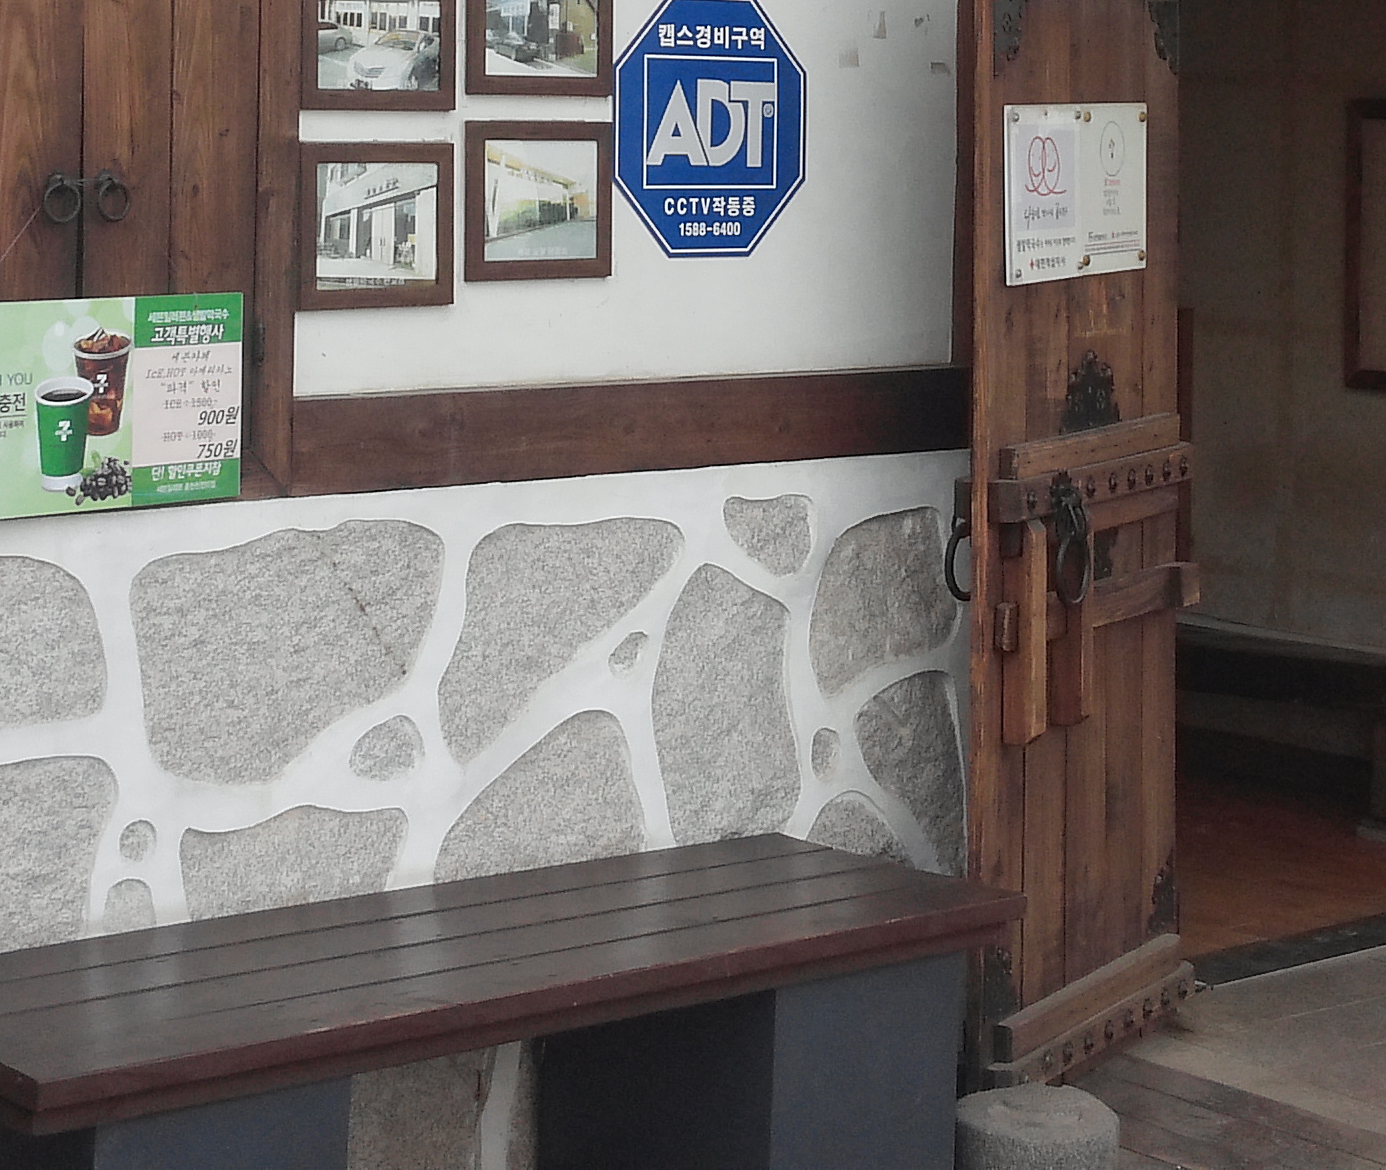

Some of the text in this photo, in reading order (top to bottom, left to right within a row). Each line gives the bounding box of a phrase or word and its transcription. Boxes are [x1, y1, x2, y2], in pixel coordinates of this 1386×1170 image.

[658, 23, 766, 50] 캡스경비구역
[645, 78, 776, 168] ADT
[663, 195, 757, 217] CCTV작동중
[678, 221, 741, 238] 1588-6400
[150, 323, 225, 346] 고객특별행사
[7, 372, 33, 386] YOU
[198, 406, 240, 426] 900원
[196, 439, 238, 458] 750원
